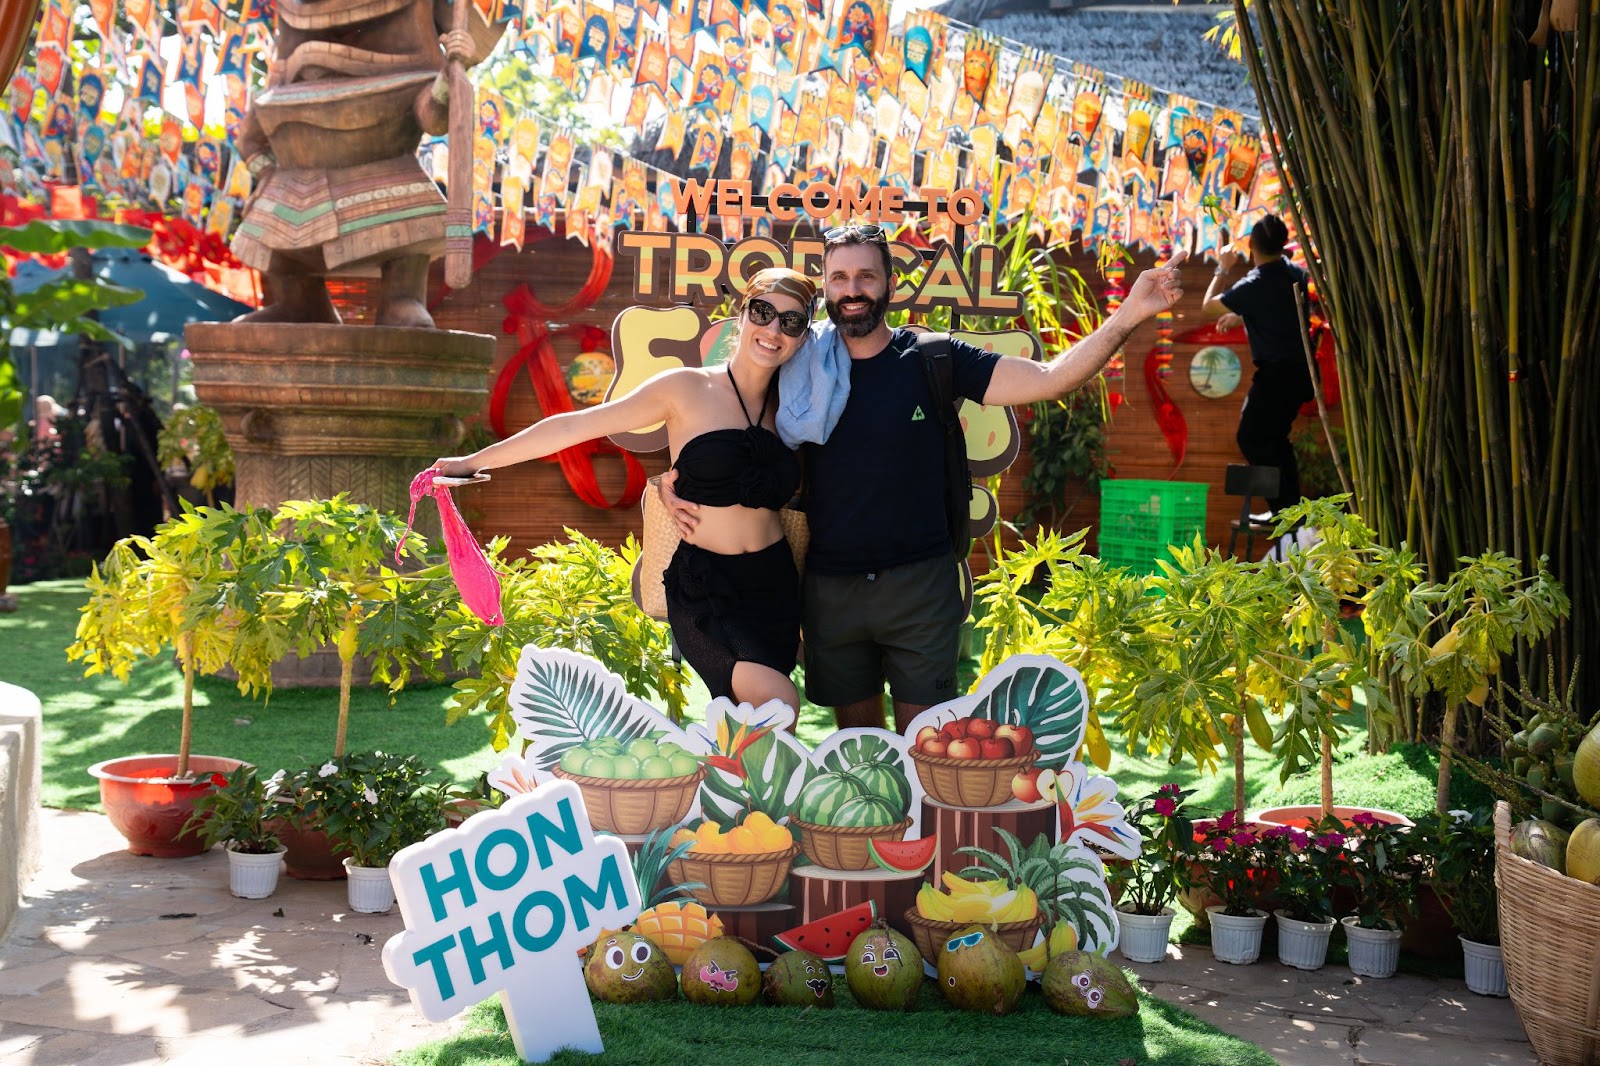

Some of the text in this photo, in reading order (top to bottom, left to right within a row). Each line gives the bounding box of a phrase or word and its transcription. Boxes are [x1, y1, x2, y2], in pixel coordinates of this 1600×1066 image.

[669, 178, 984, 226] WELCOME TO
[419, 797, 584, 923] HON
[412, 854, 630, 1002] THOM
